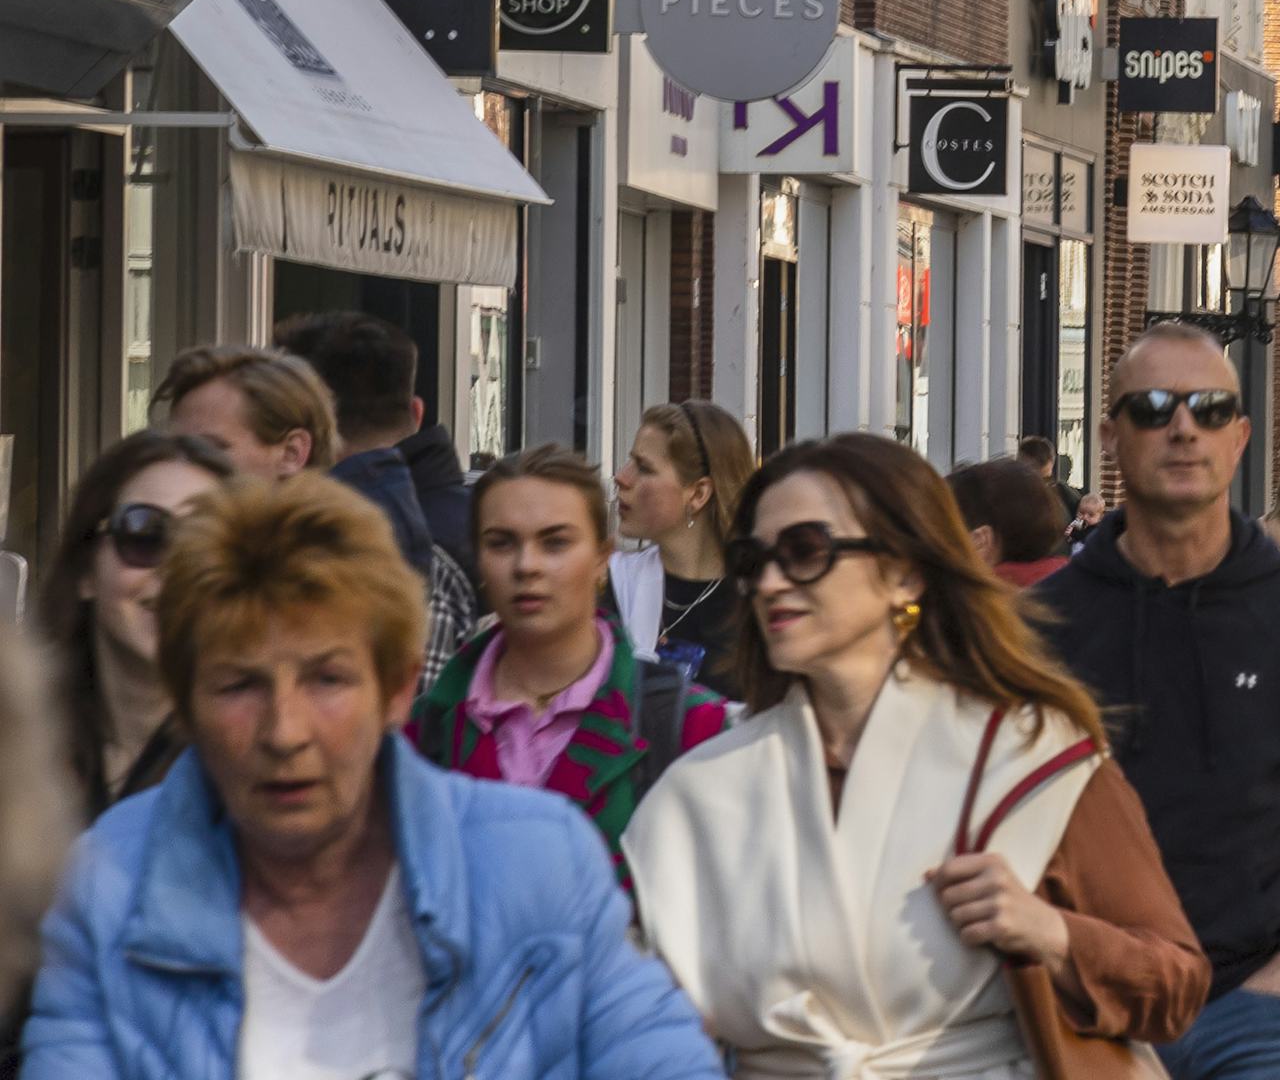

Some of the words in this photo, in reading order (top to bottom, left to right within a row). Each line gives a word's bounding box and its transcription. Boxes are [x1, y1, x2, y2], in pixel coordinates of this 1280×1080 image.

[1125, 49, 1204, 84] snipes
[1140, 174, 1215, 189] SCOTCH
[1162, 189, 1215, 204] SODA
[1140, 205, 1215, 214] AMSTERDAM
